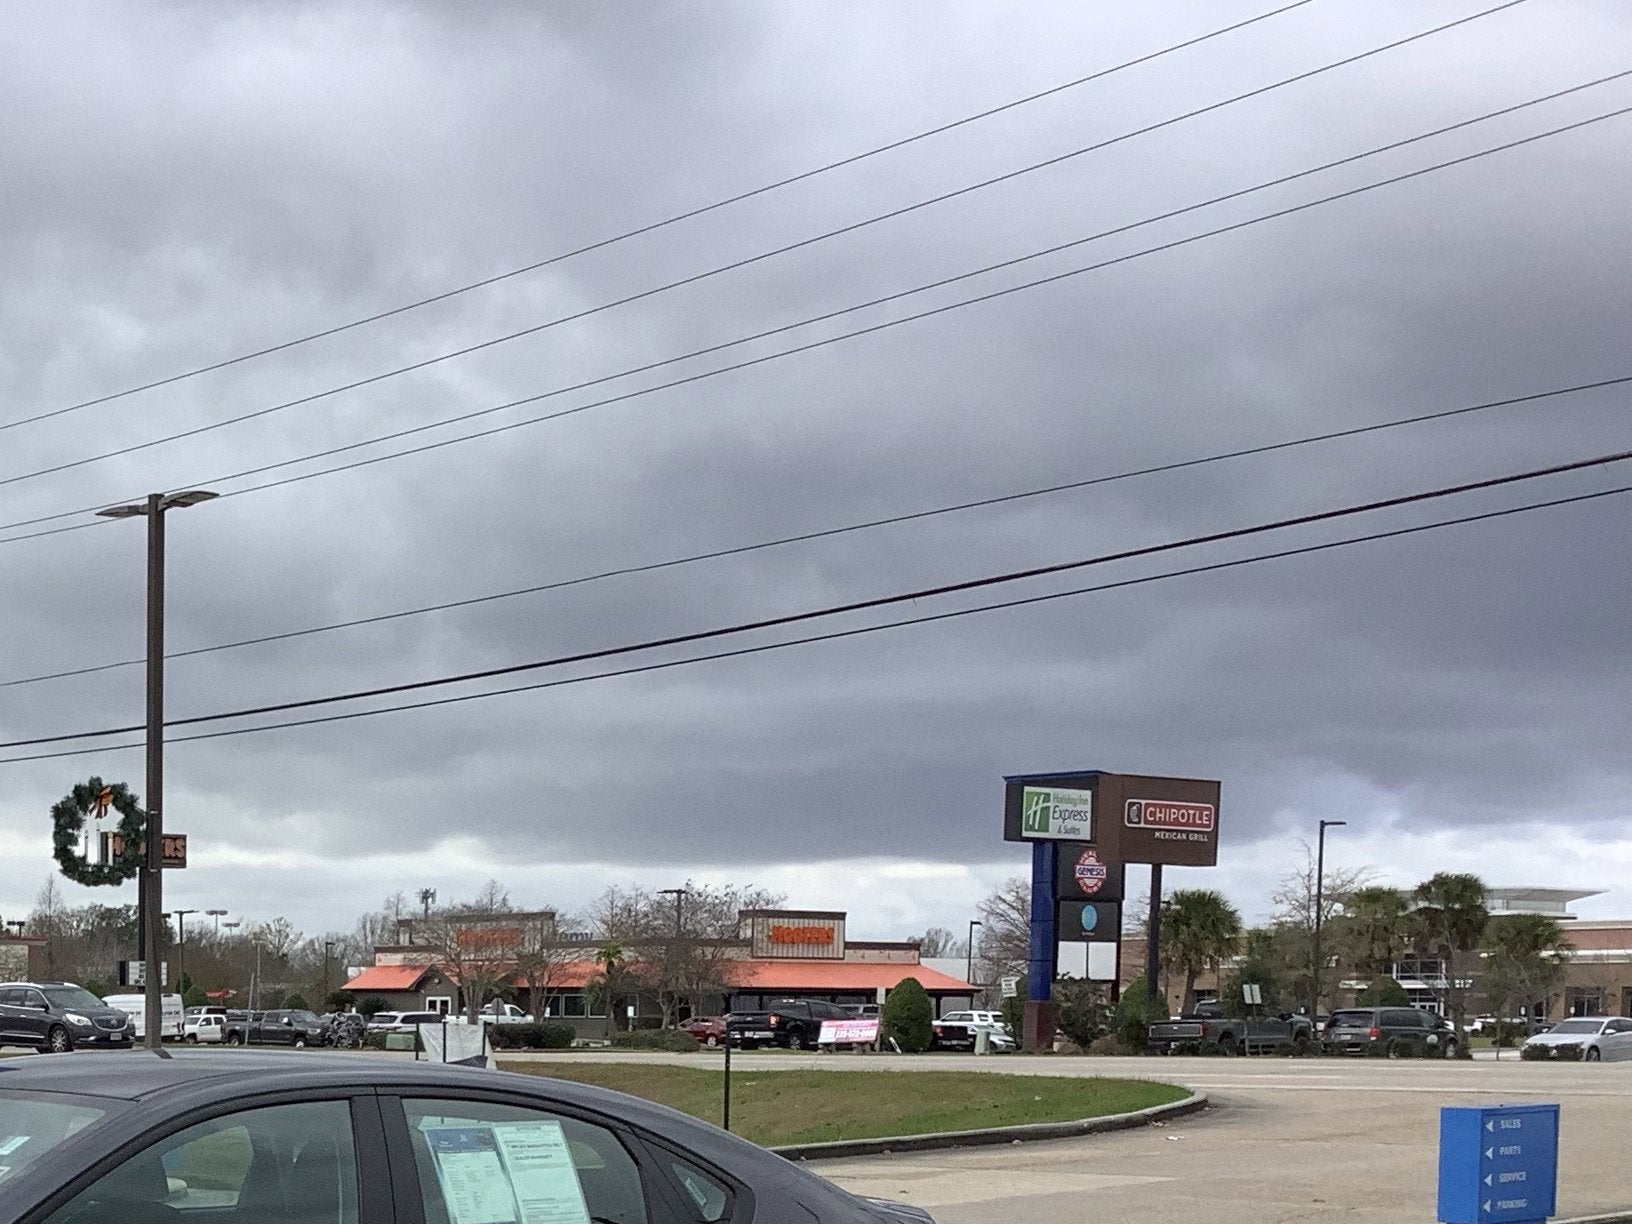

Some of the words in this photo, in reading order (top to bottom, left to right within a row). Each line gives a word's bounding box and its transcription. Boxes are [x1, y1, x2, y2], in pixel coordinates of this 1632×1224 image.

[1052, 805, 1089, 824] Express
[1146, 807, 1211, 825] CHIPOTLE
[1154, 831, 1187, 840] MEXICAN
[1188, 833, 1209, 842] GRILL
[1500, 1118, 1522, 1130] SALES
[1499, 1171, 1527, 1183] SERVICE
